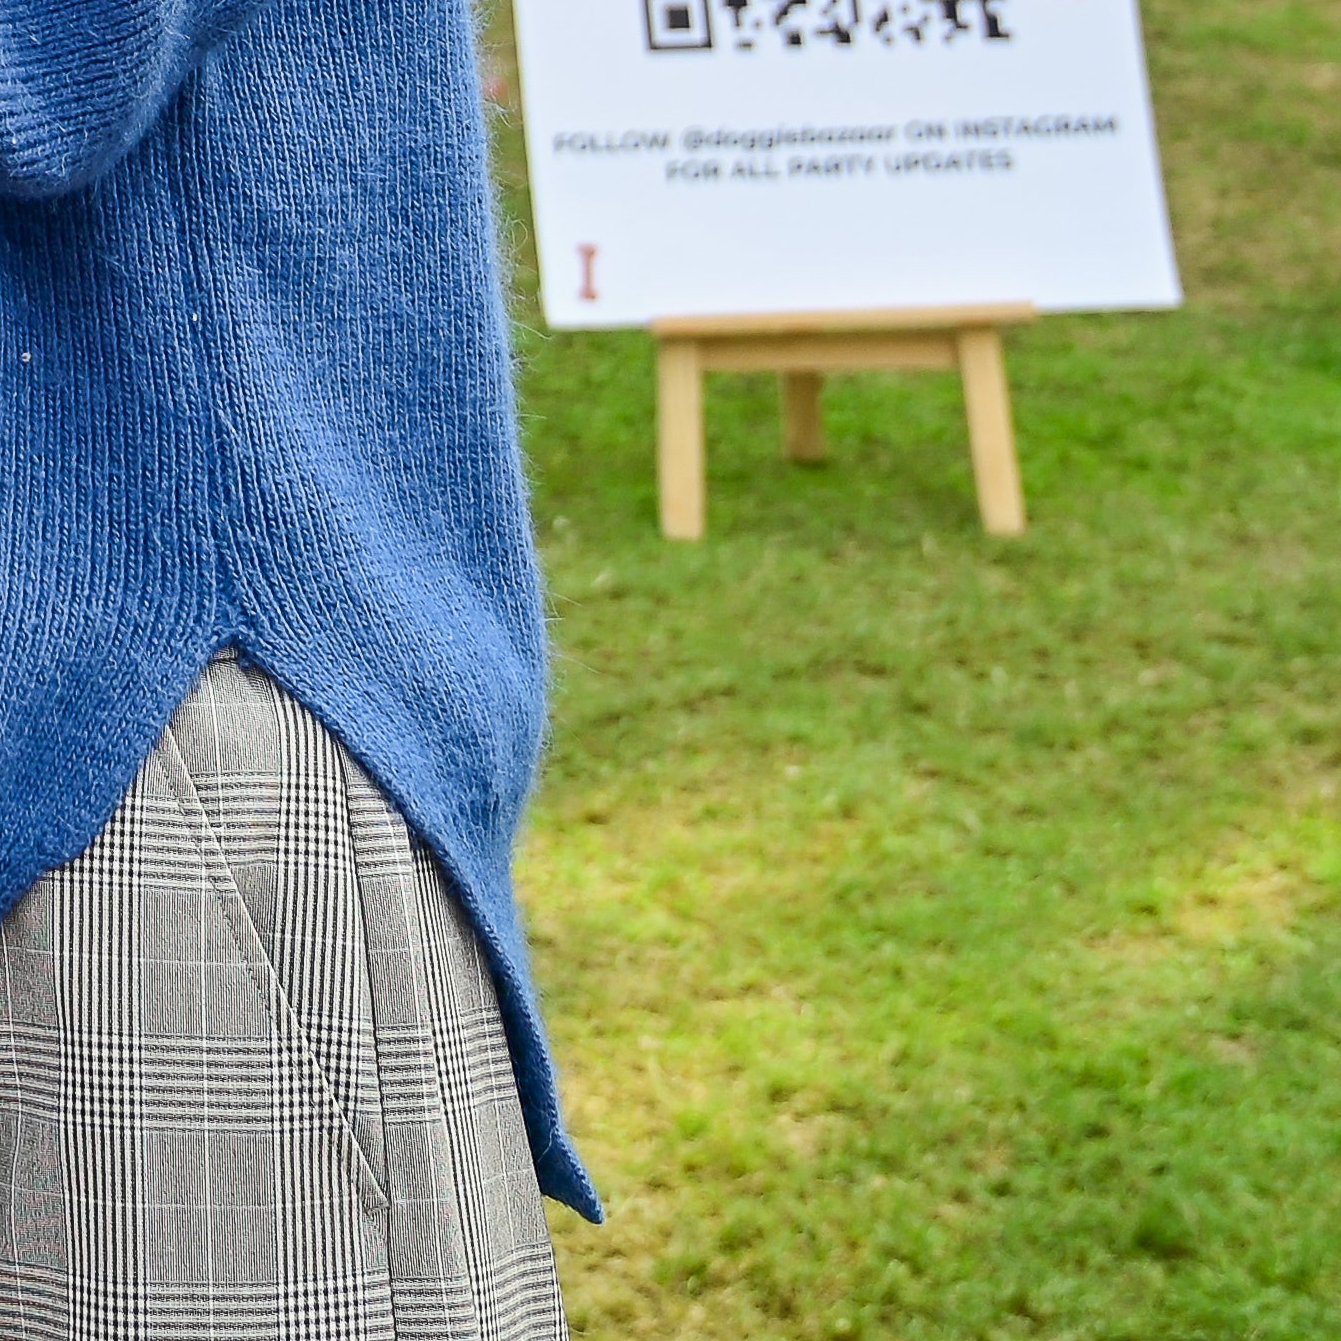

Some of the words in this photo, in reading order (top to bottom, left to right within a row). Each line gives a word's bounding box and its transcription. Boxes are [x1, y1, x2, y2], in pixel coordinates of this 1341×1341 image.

[553, 130, 670, 154] FOLLOW
[904, 120, 946, 142] ON
[955, 115, 1118, 140] INSTAGRAM
[666, 160, 721, 182] FOR
[730, 158, 779, 180] ALL
[788, 155, 874, 178] PARTY
[883, 150, 1014, 175] UPDATES
